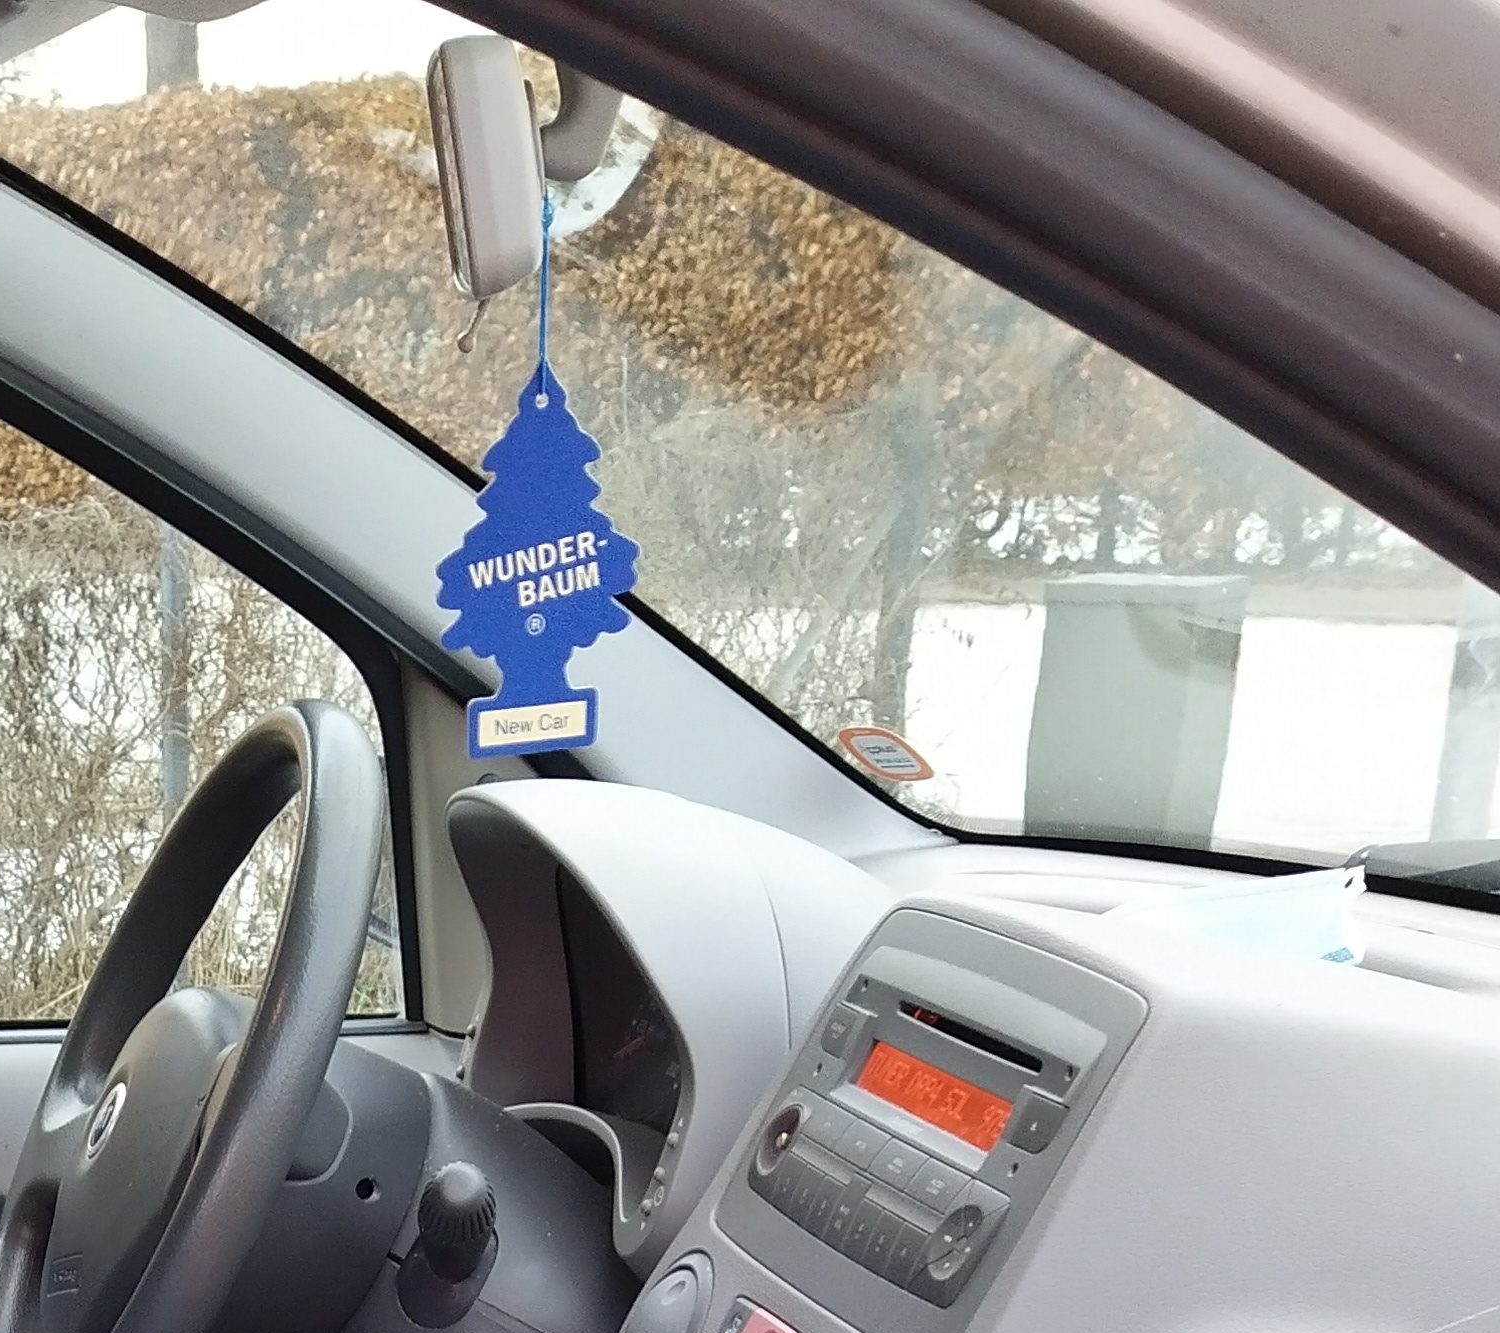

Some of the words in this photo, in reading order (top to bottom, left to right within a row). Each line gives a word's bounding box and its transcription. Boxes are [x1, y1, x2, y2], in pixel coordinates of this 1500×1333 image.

[469, 531, 608, 589] WUNDER-
[518, 561, 600, 607] BAUM
[495, 718, 534, 736] New
[539, 713, 570, 732] Car
